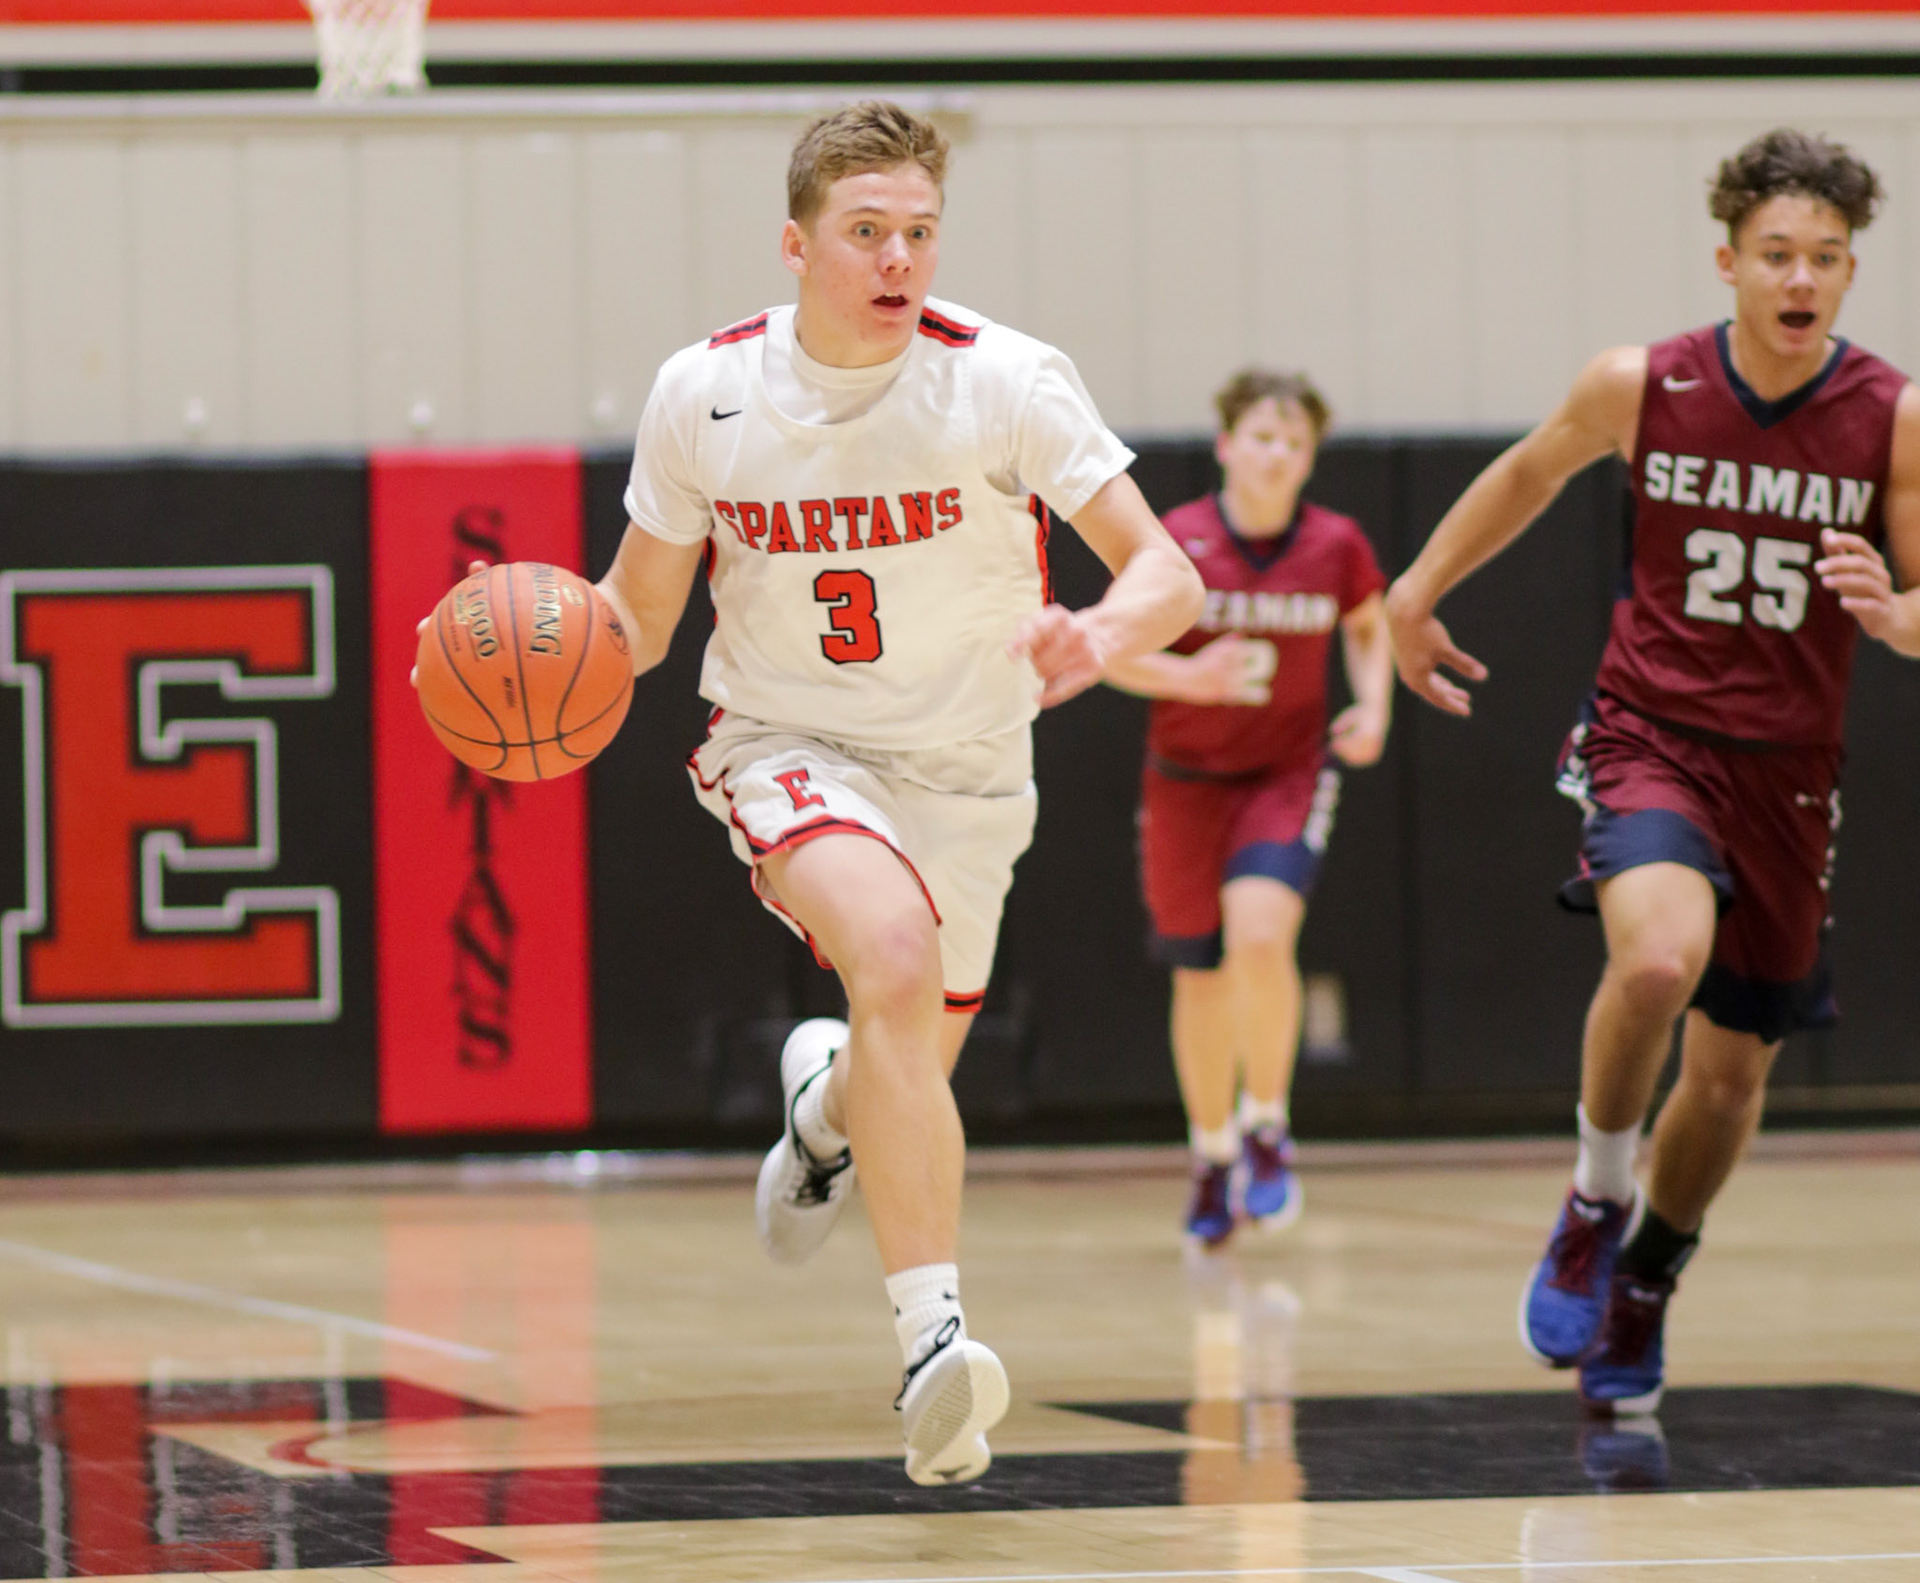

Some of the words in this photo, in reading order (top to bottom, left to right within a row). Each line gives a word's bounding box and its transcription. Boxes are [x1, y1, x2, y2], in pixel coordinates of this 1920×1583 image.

[714, 487, 963, 555] SPARTANS
[1644, 451, 1876, 526] SEAMAN
[525, 562, 563, 659] PALDING
[813, 568, 884, 665] 3
[1198, 588, 1339, 635] EAMAN
[1684, 528, 1812, 633] 25
[0, 564, 341, 1028] E
[449, 504, 516, 1070] STANS
[772, 767, 827, 813] E
